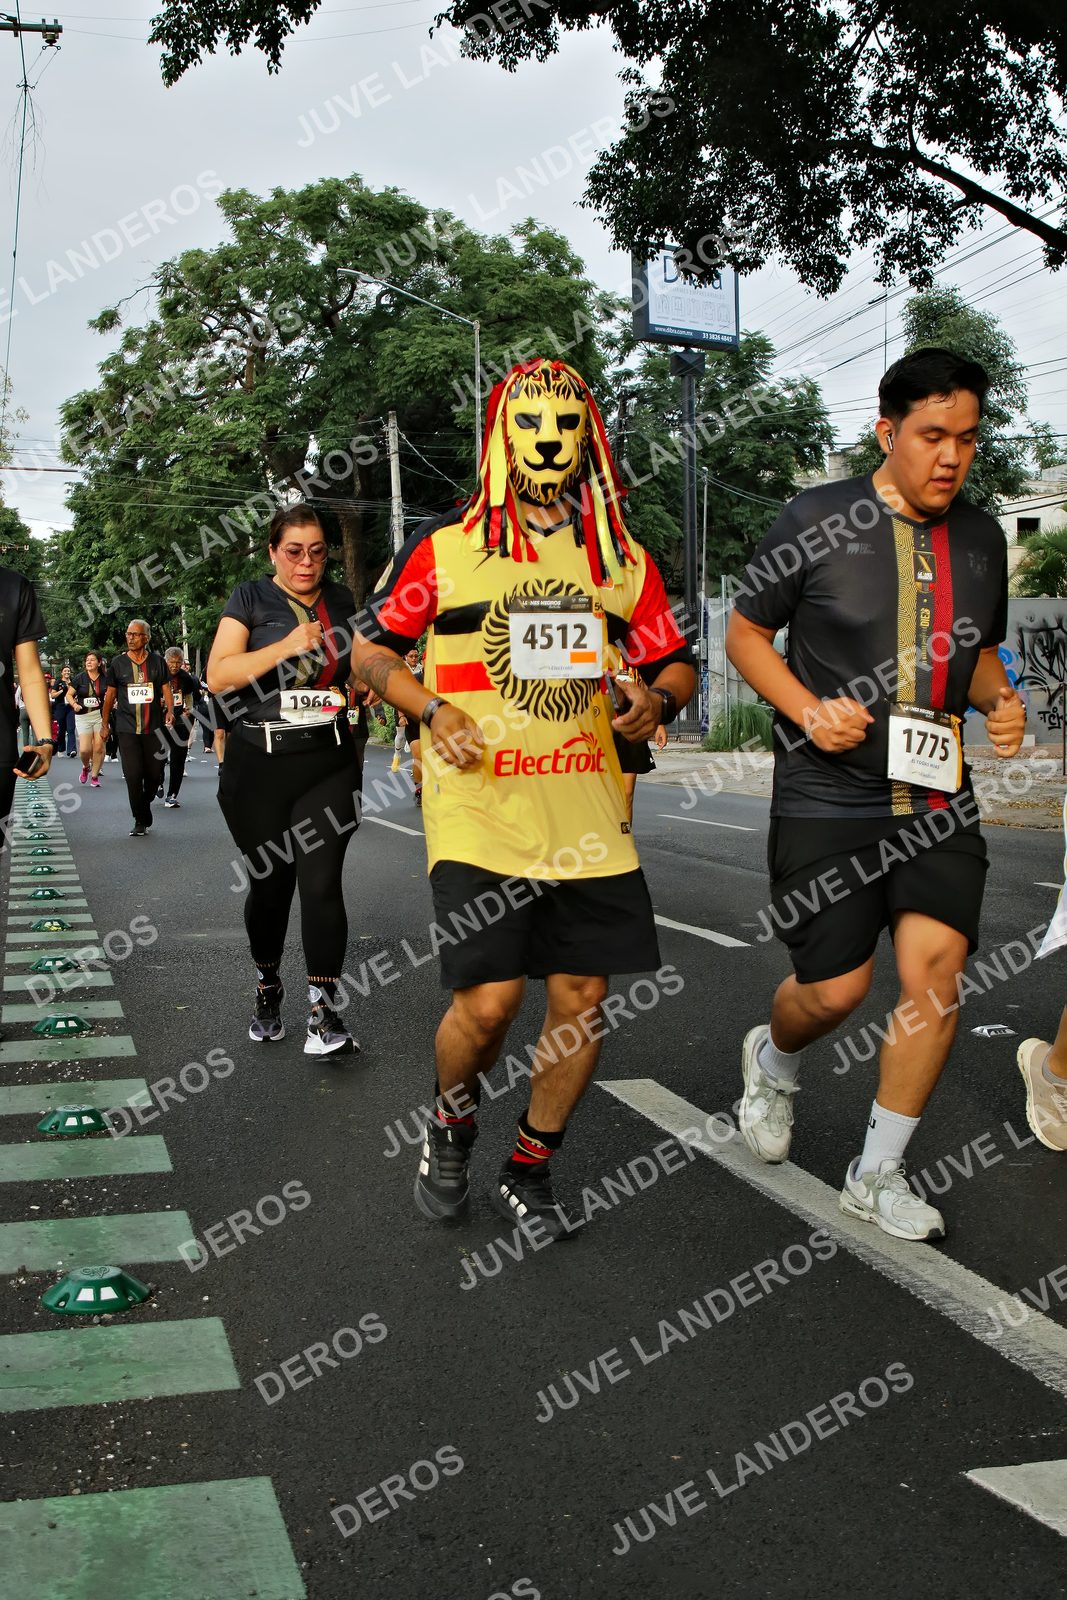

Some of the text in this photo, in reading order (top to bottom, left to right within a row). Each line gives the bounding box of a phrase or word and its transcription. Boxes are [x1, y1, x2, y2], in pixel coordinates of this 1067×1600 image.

[523, 623, 587, 649] 4512
[131, 689, 148, 697] 6742
[290, 695, 333, 709] 1966
[902, 727, 950, 762] 1775
